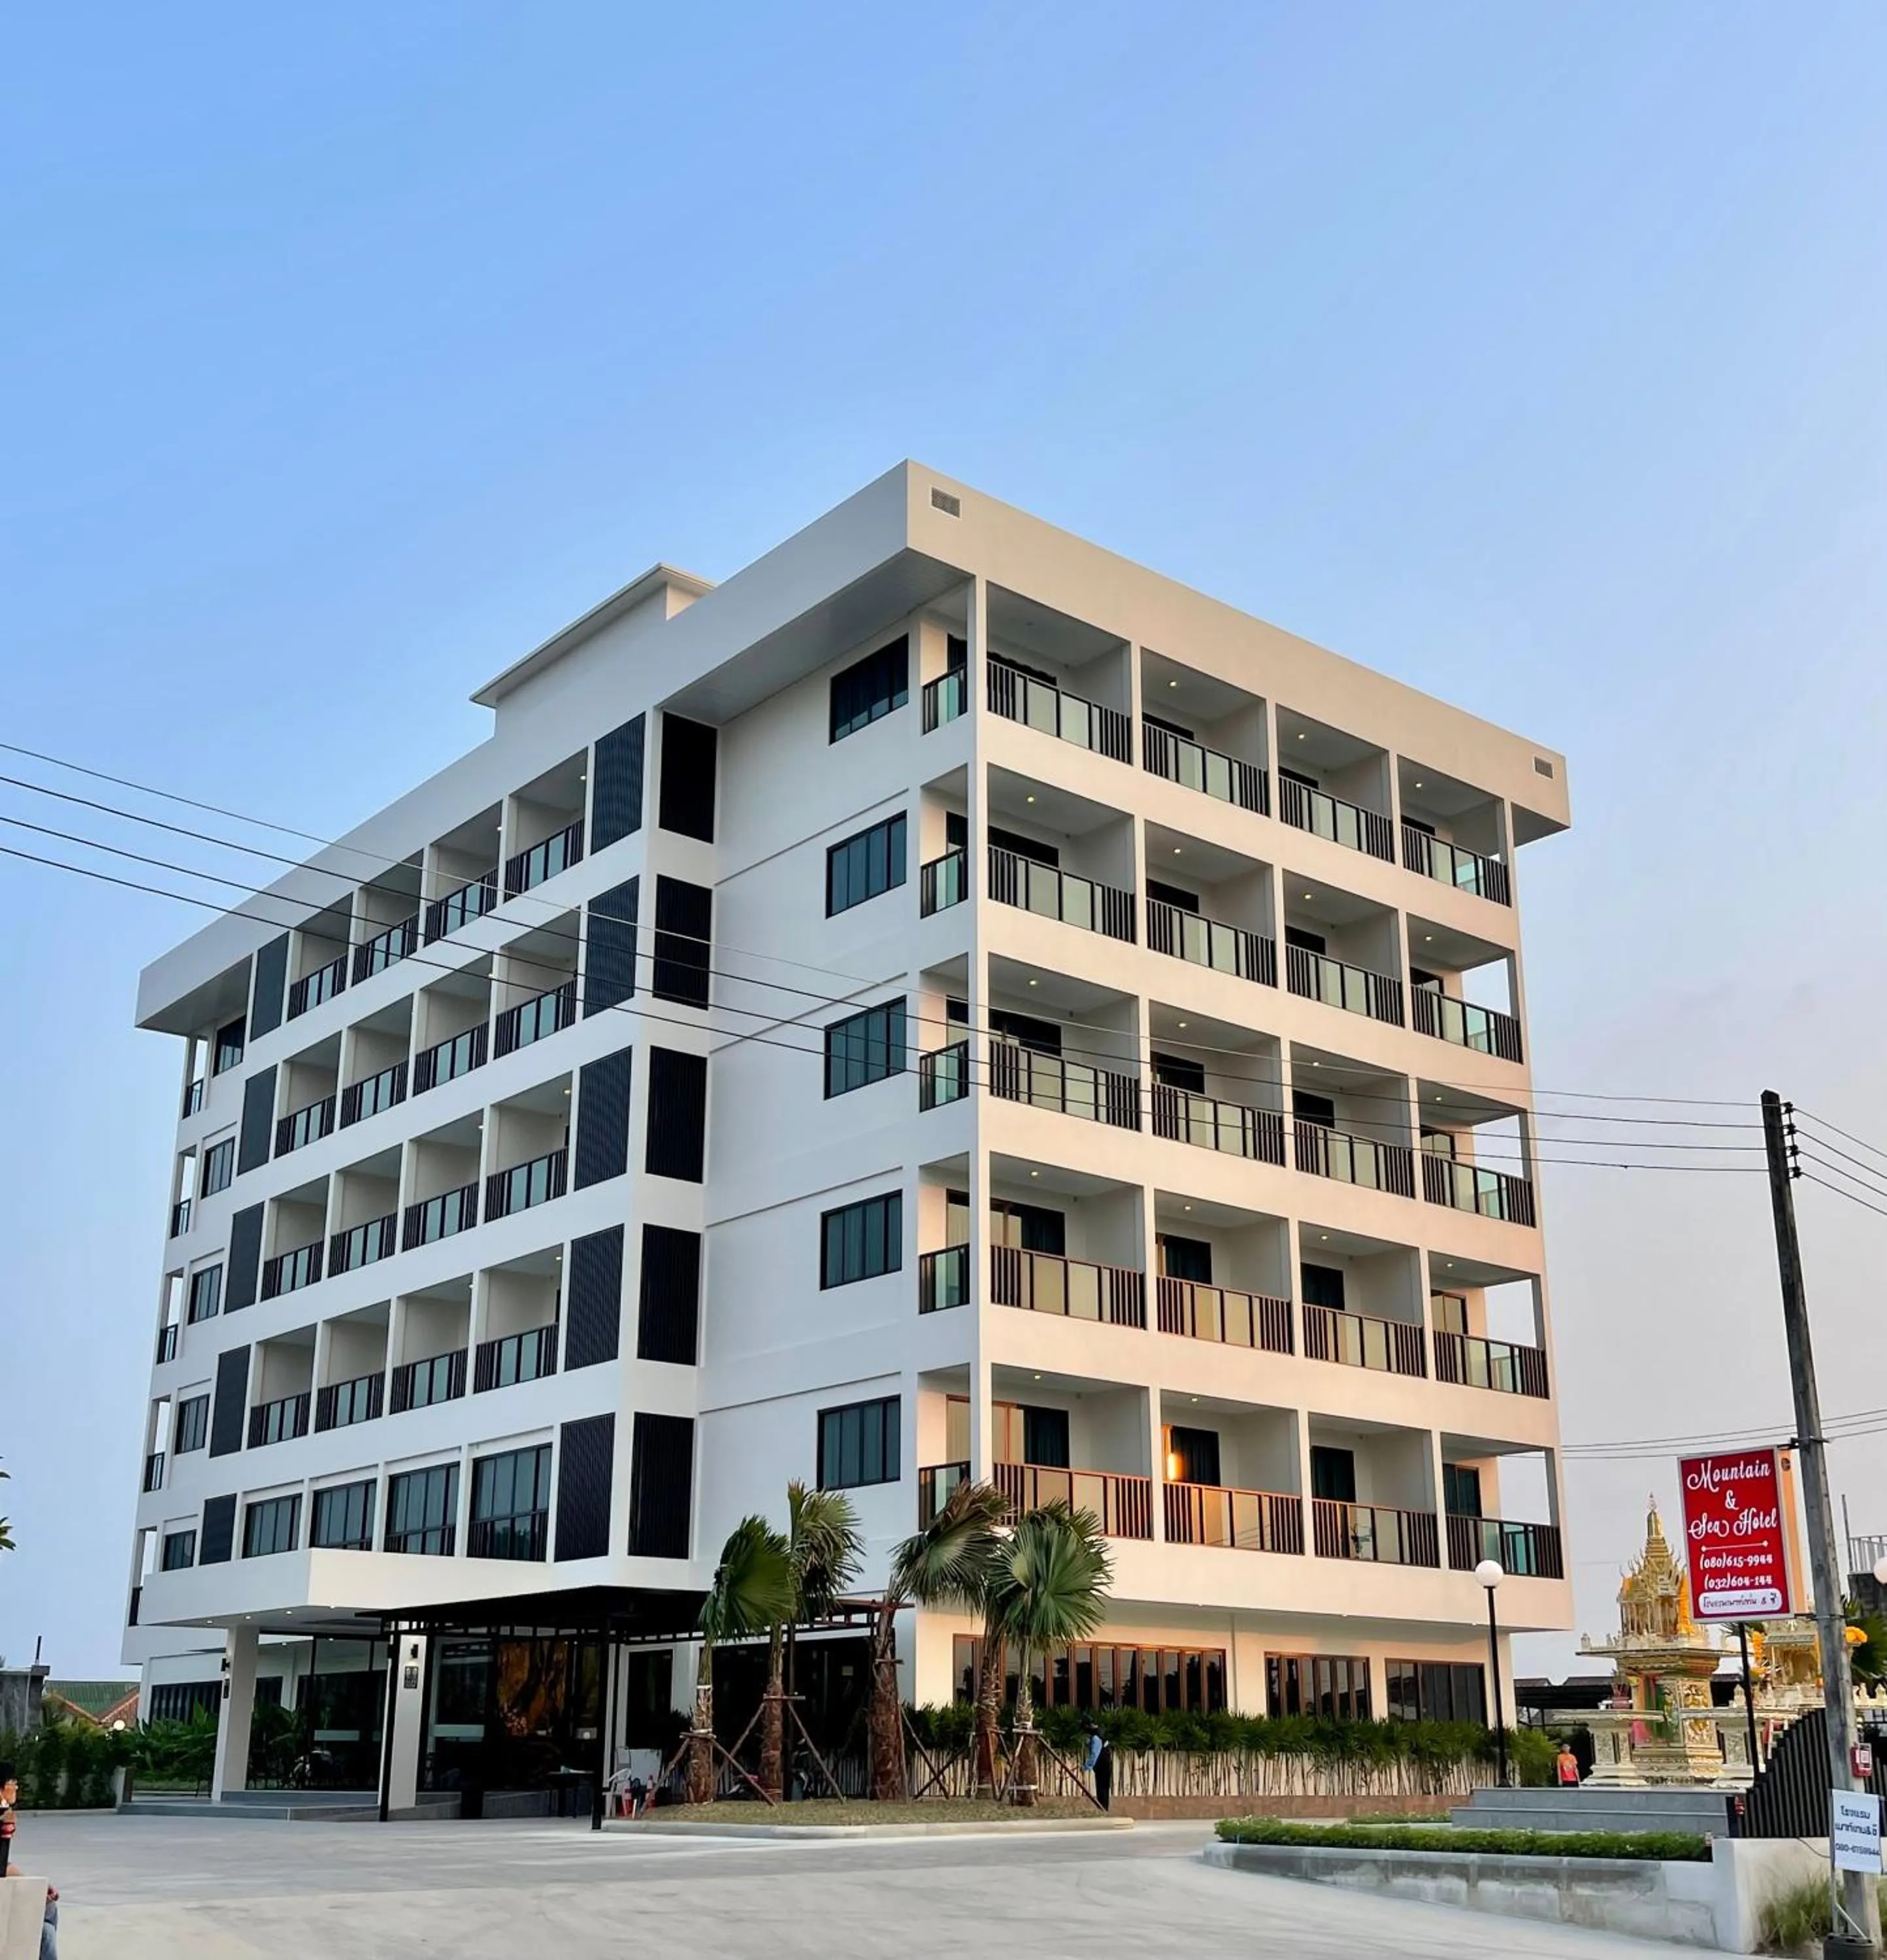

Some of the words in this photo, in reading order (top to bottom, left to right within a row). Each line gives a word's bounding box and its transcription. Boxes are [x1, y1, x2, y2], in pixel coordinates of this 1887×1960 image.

[1687, 1460, 1771, 1493] Mountain
[1725, 1490, 1739, 1510] &
[1688, 1512, 1730, 1540] Sea
[1733, 1508, 1777, 1536] Hotel
